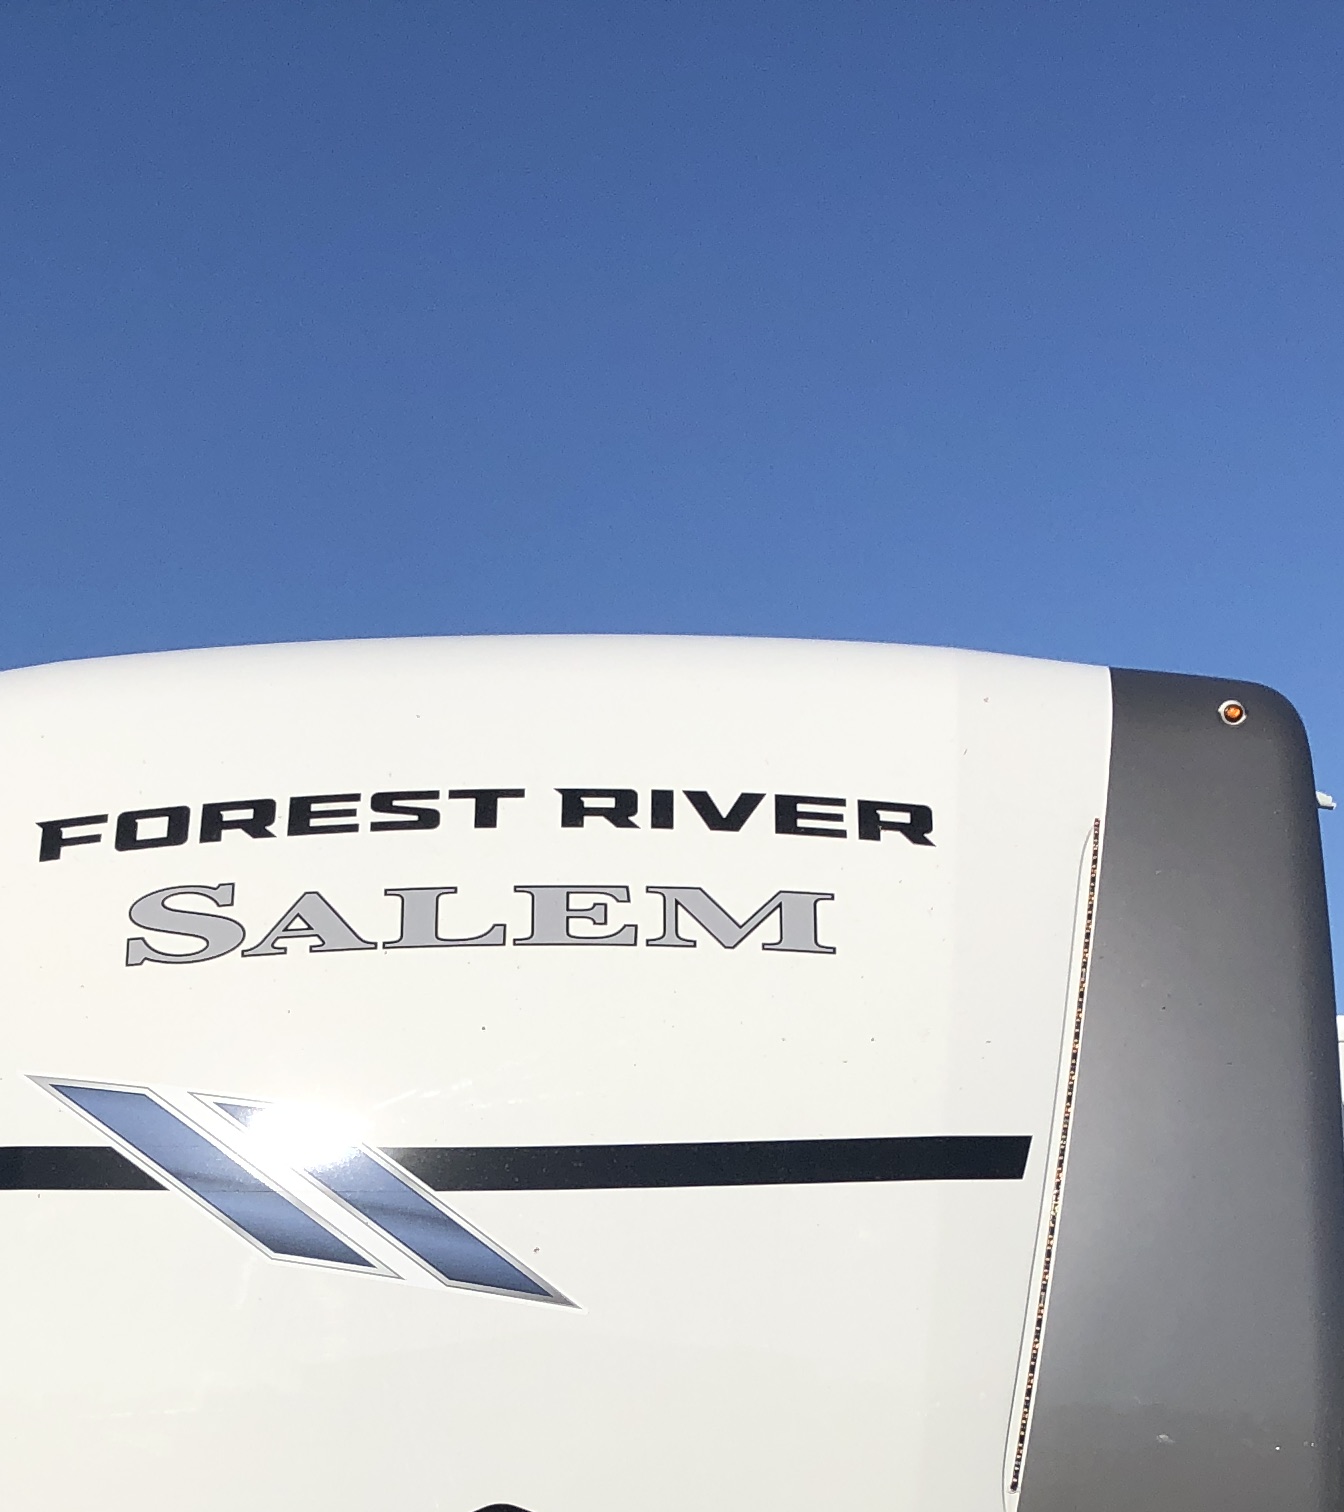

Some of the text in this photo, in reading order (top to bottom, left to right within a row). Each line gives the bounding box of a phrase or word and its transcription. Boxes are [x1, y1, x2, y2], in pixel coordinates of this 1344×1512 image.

[35, 787, 937, 862] FOREST RIVER
[125, 882, 837, 967] SALEM
